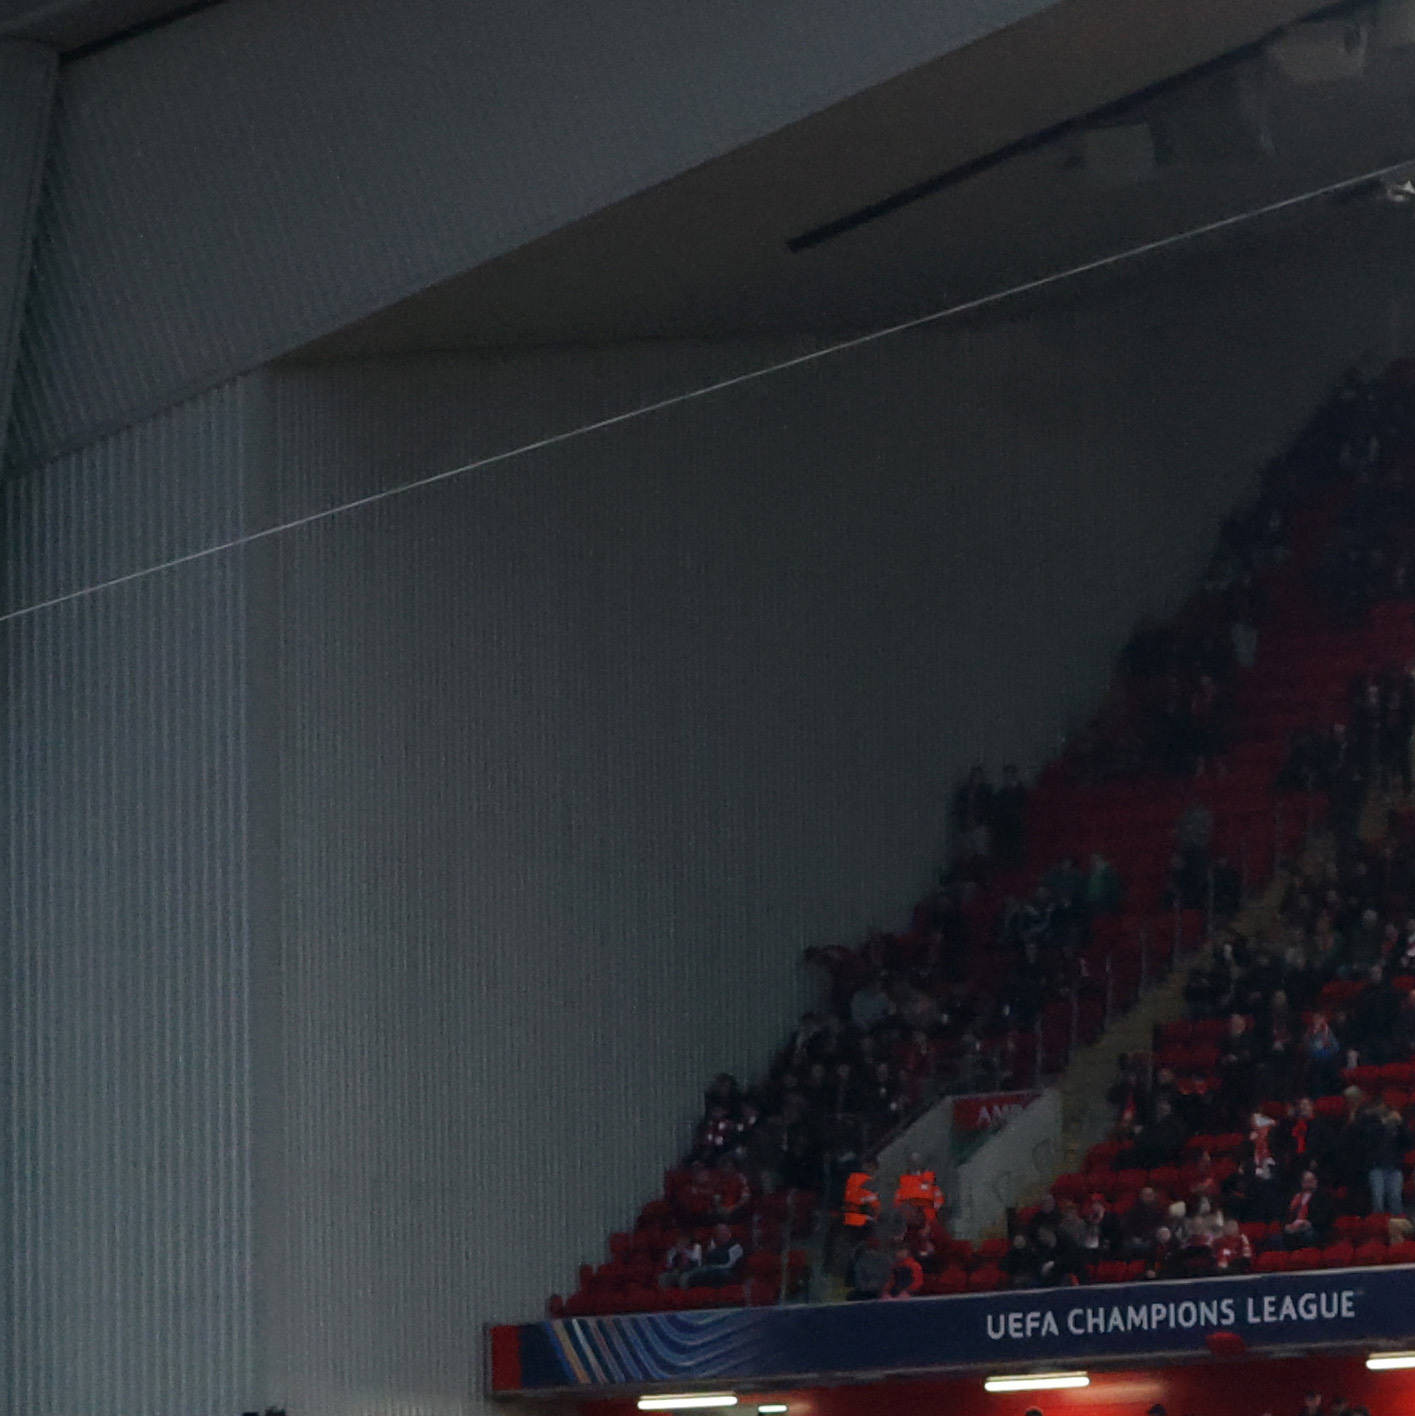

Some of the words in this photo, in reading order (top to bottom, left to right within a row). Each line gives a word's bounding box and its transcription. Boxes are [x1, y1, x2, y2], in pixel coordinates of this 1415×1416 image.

[985, 1310, 1059, 1340] UEFA
[1065, 1298, 1236, 1335] CHAMPIONS
[1245, 1290, 1356, 1324] LEAGUE
